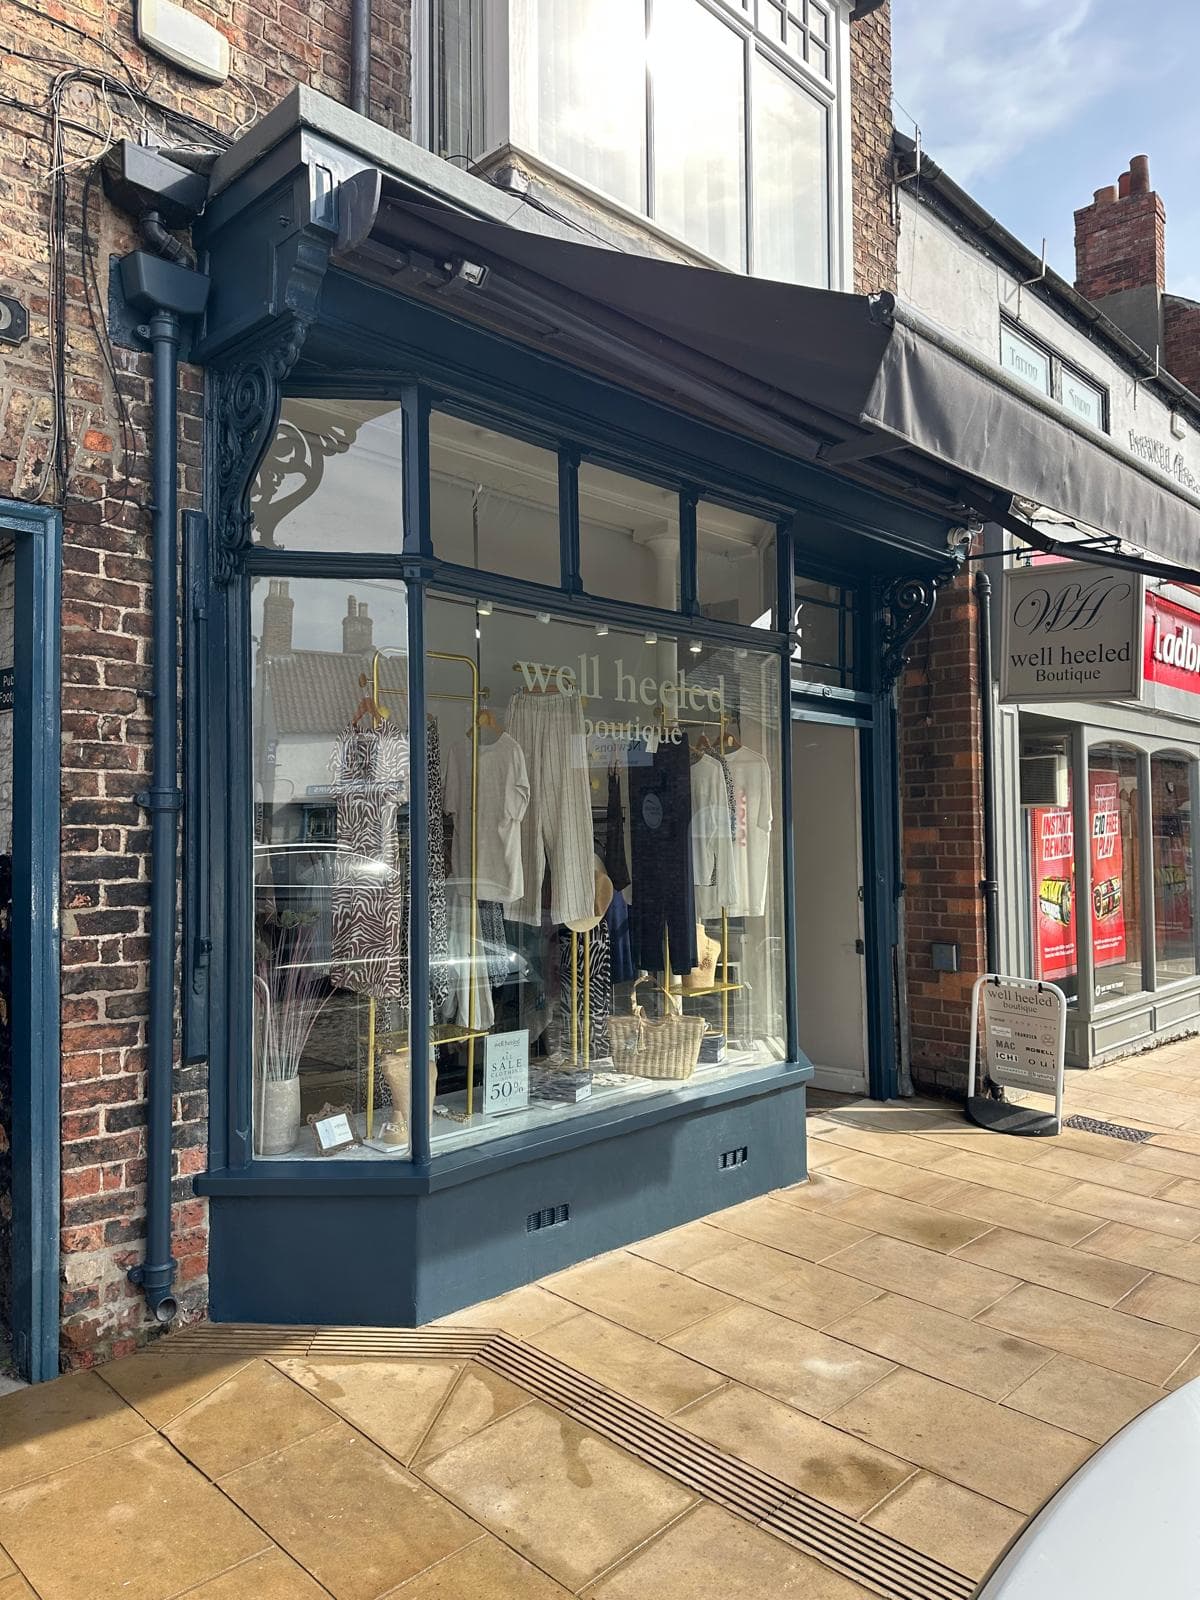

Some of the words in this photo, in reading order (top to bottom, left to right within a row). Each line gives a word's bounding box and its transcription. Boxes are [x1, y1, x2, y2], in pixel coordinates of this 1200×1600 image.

[1010, 646, 1052, 667] well
[1061, 641, 1131, 665] heeled
[517, 653, 603, 700] well
[614, 658, 725, 714] heeled
[1035, 666, 1101, 684] Boutique
[584, 715, 683, 748] boutique
[1045, 836, 1072, 857] REWARD
[1098, 836, 1114, 856] PLAY
[988, 990, 1011, 1001] well
[1015, 992, 1053, 1007] heeled
[1003, 1001, 1038, 1013] boutique
[996, 1039, 1016, 1050] MAC
[492, 1058, 522, 1072] SALE
[996, 1052, 1018, 1062] ICHI
[490, 1081, 524, 1100] 50%
